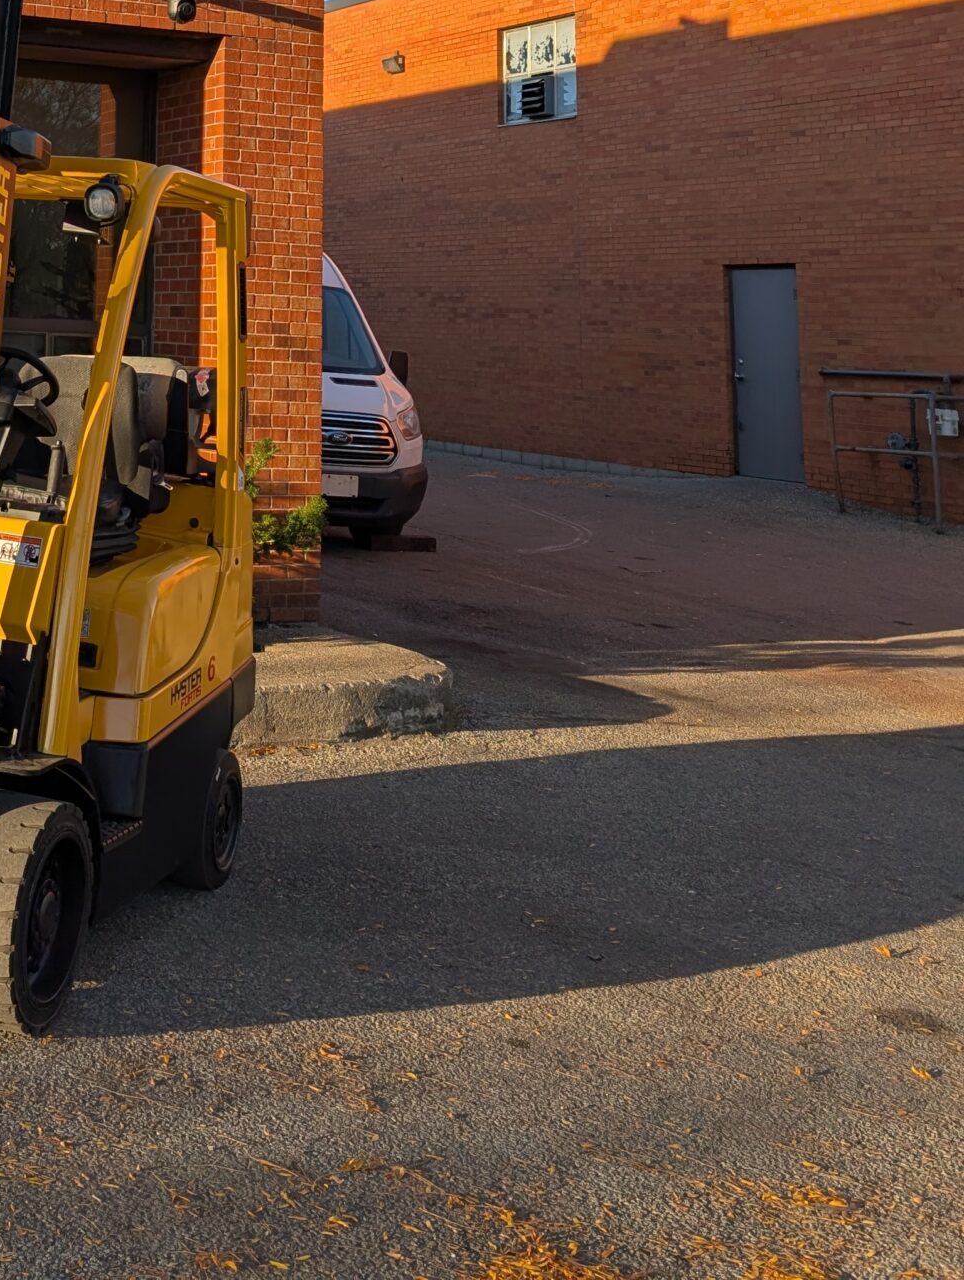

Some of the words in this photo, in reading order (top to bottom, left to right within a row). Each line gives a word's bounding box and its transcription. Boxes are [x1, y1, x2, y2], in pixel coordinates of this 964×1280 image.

[208, 656, 216, 682] 6
[170, 666, 202, 706] HYSTER
[181, 684, 202, 710] FORTIS
